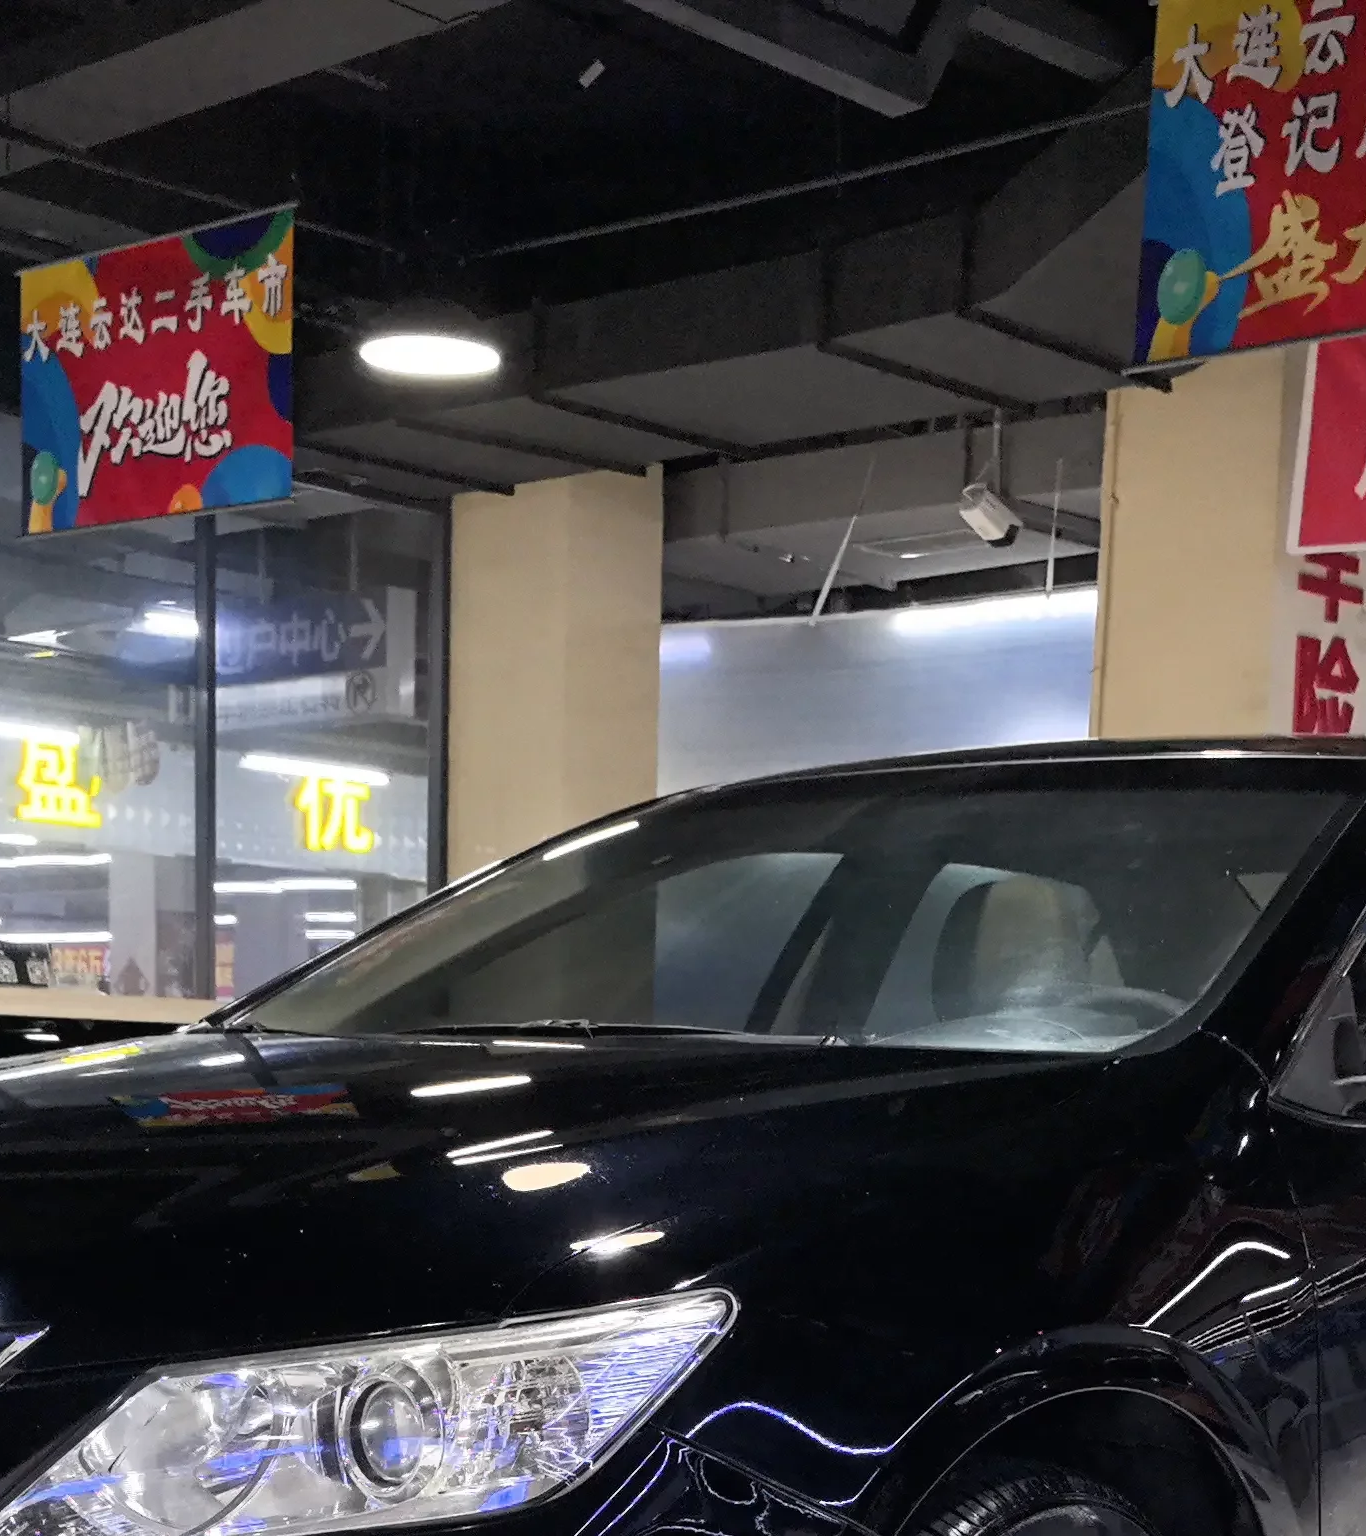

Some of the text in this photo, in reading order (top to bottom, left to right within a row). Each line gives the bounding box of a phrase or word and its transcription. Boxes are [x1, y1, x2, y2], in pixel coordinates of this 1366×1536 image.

[24, 253, 288, 362] 大连云达二手车市
[77, 350, 233, 499] 欢迎您
